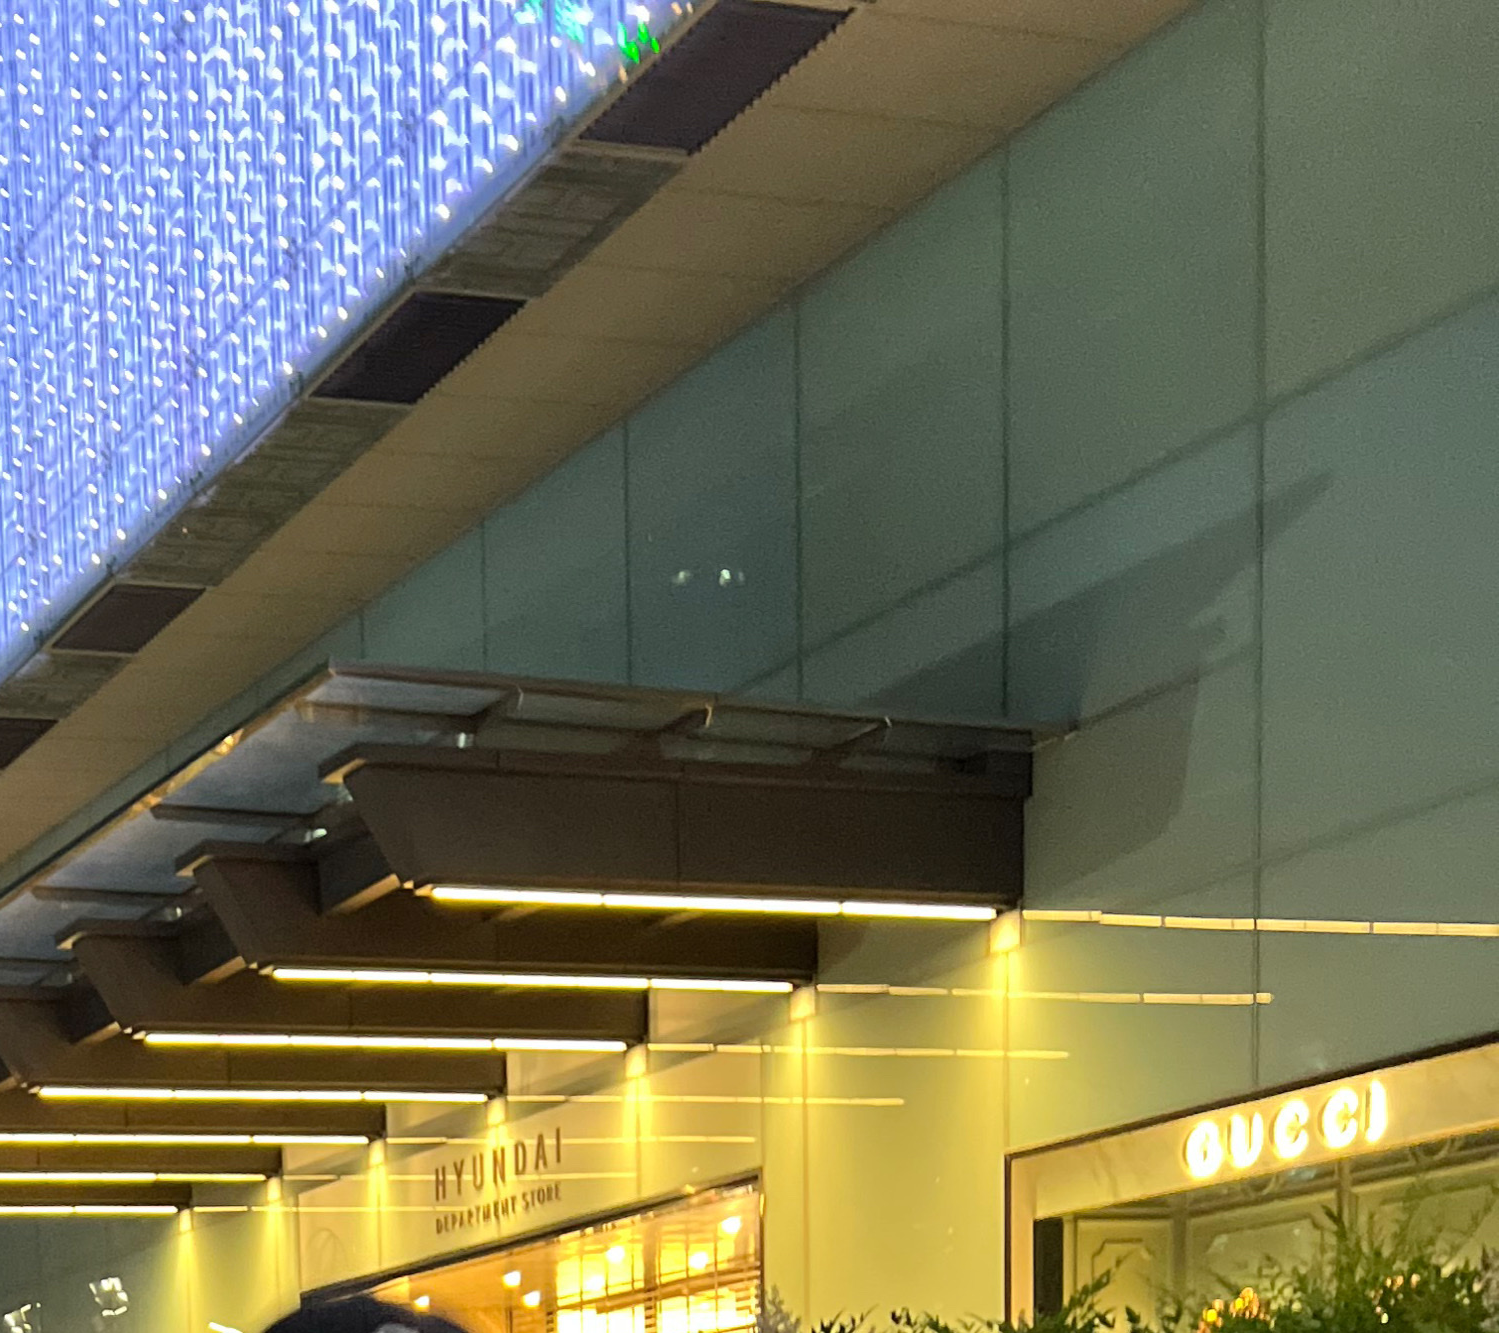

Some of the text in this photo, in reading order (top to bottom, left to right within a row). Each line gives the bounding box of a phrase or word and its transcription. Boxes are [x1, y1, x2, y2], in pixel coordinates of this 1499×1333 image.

[435, 1126, 561, 1202] HYUNDAI
[1183, 1079, 1387, 1178] GUCCI
[435, 1183, 561, 1235] DEPARTMENT STORE
